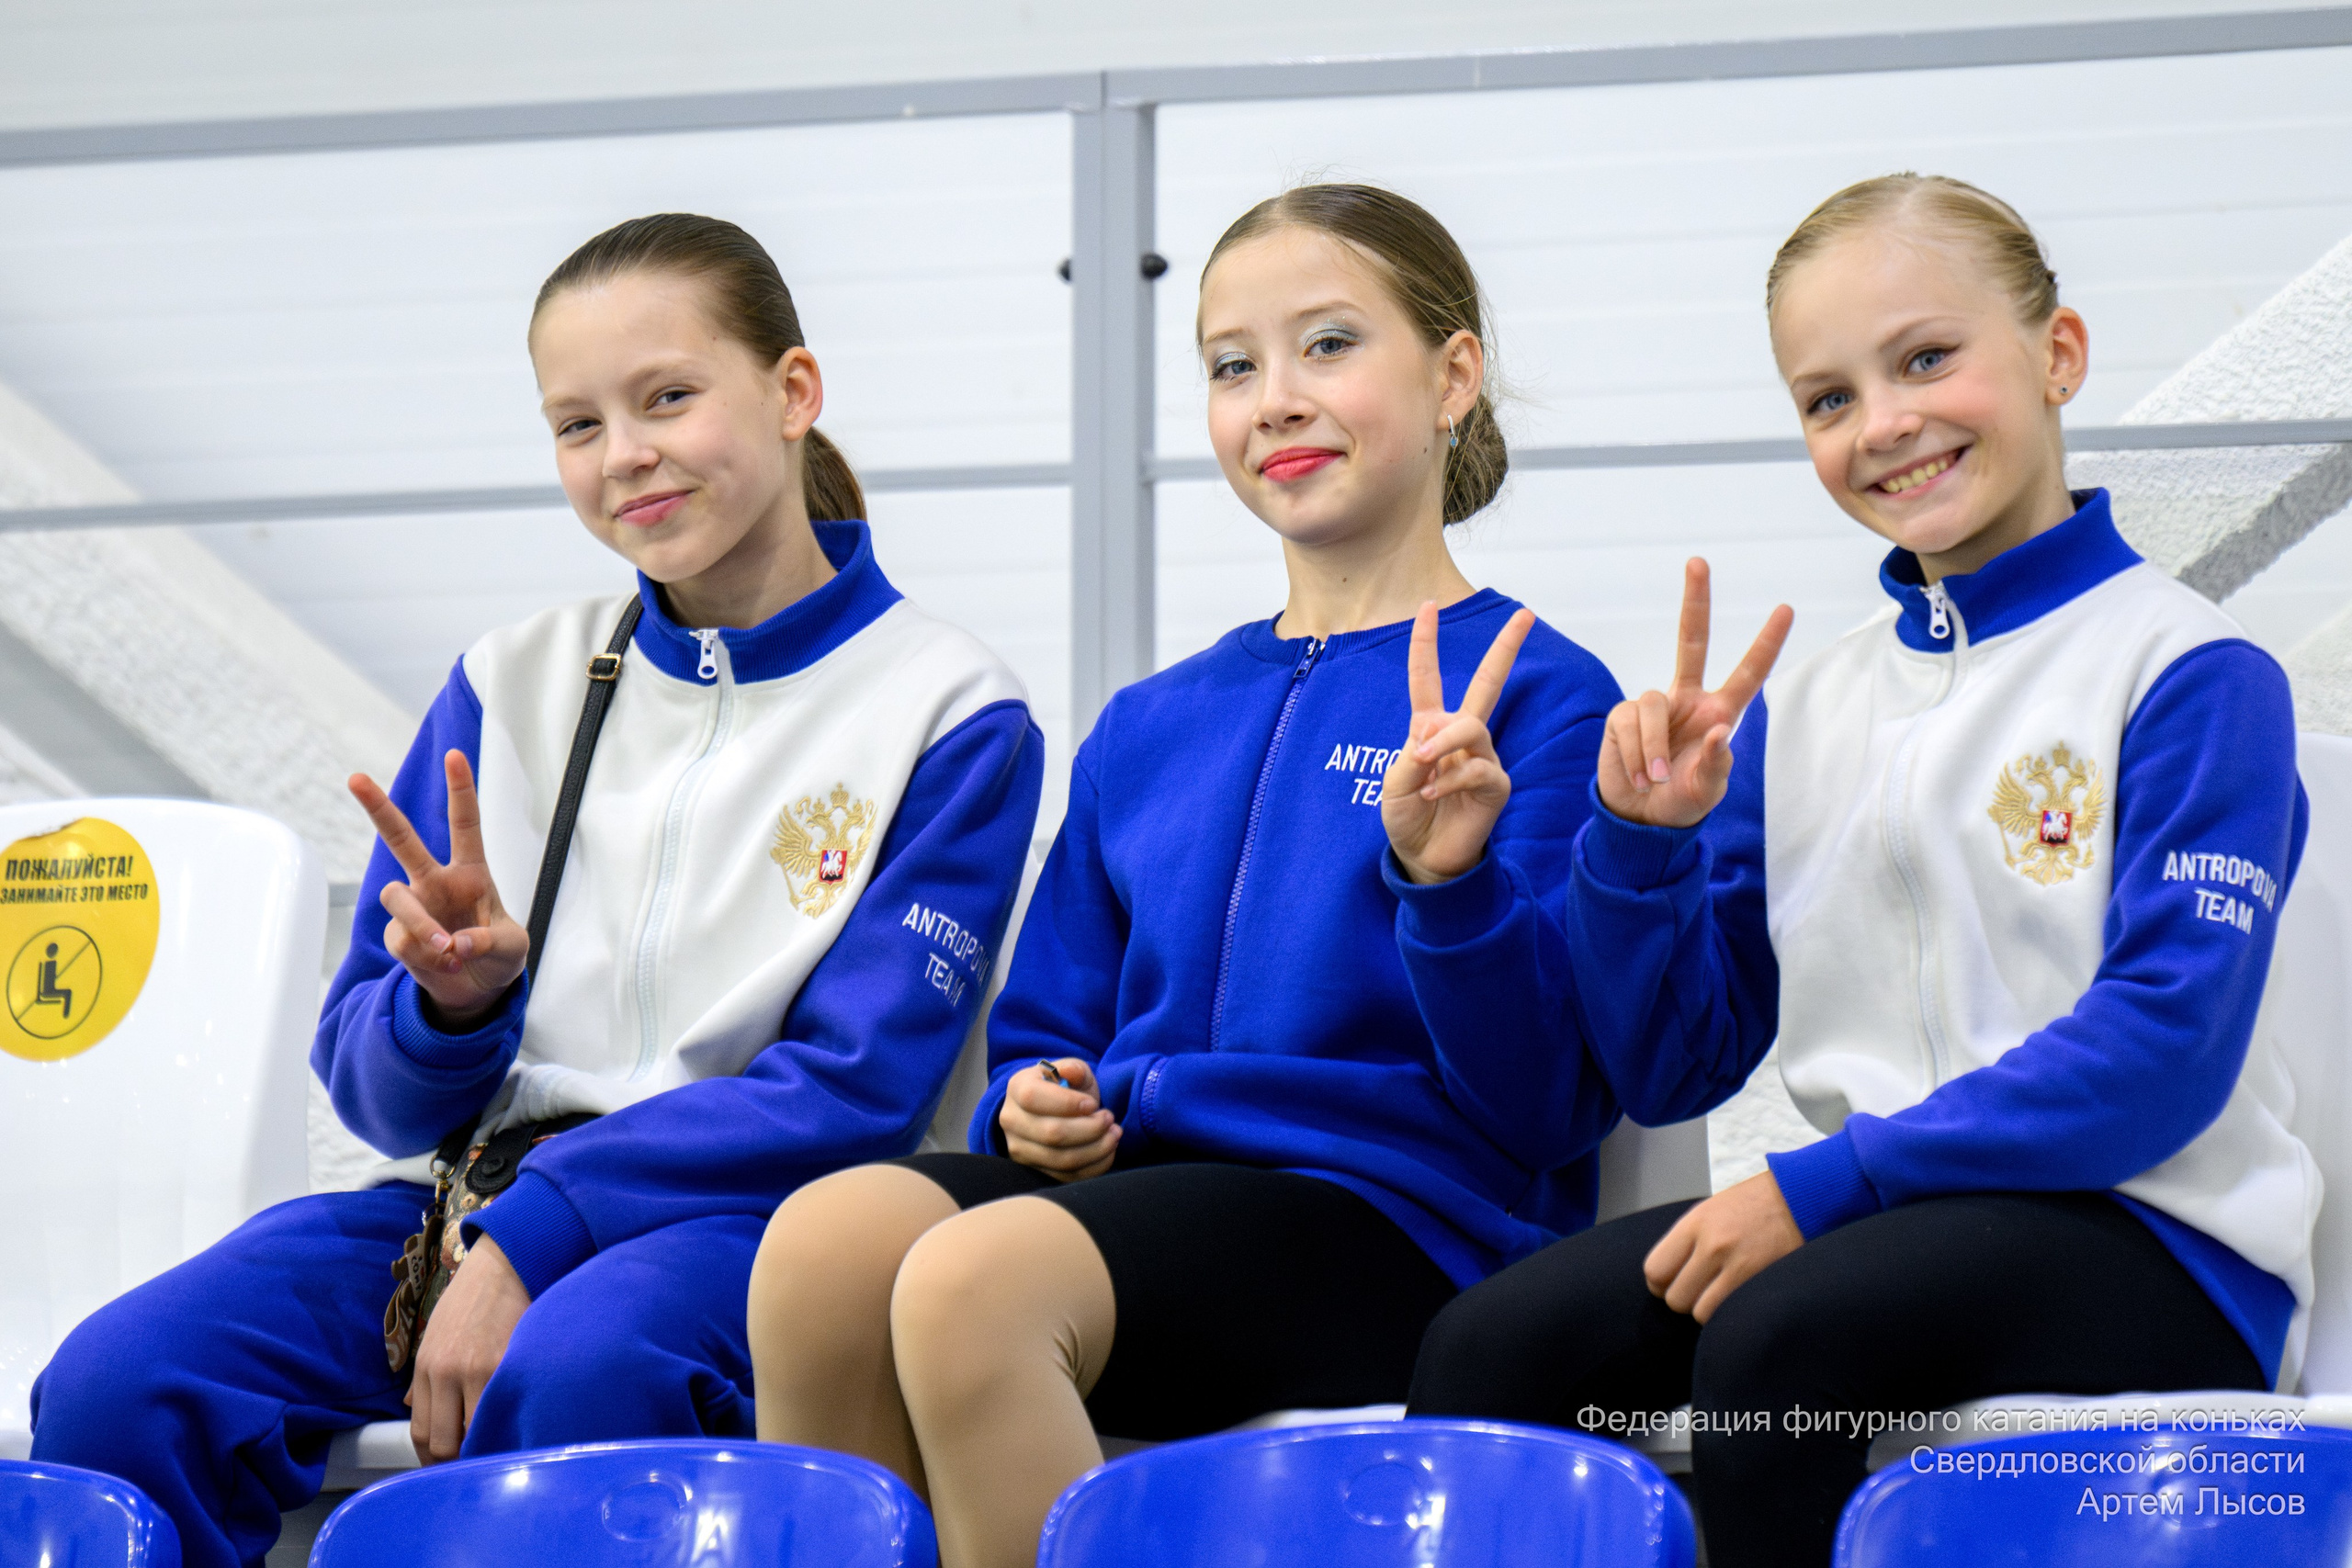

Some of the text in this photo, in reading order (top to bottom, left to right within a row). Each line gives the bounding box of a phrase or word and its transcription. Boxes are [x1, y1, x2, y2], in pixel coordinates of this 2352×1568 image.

[5, 853, 134, 881] ПОЖАЛУЙСТА!
[2162, 850, 2278, 913] ANTROPOVA
[0, 883, 149, 904] ЗАНИМАЙТЕ ЭТО МЕСТО
[2194, 886, 2255, 935] TEAM
[924, 952, 966, 1008] TEAM
